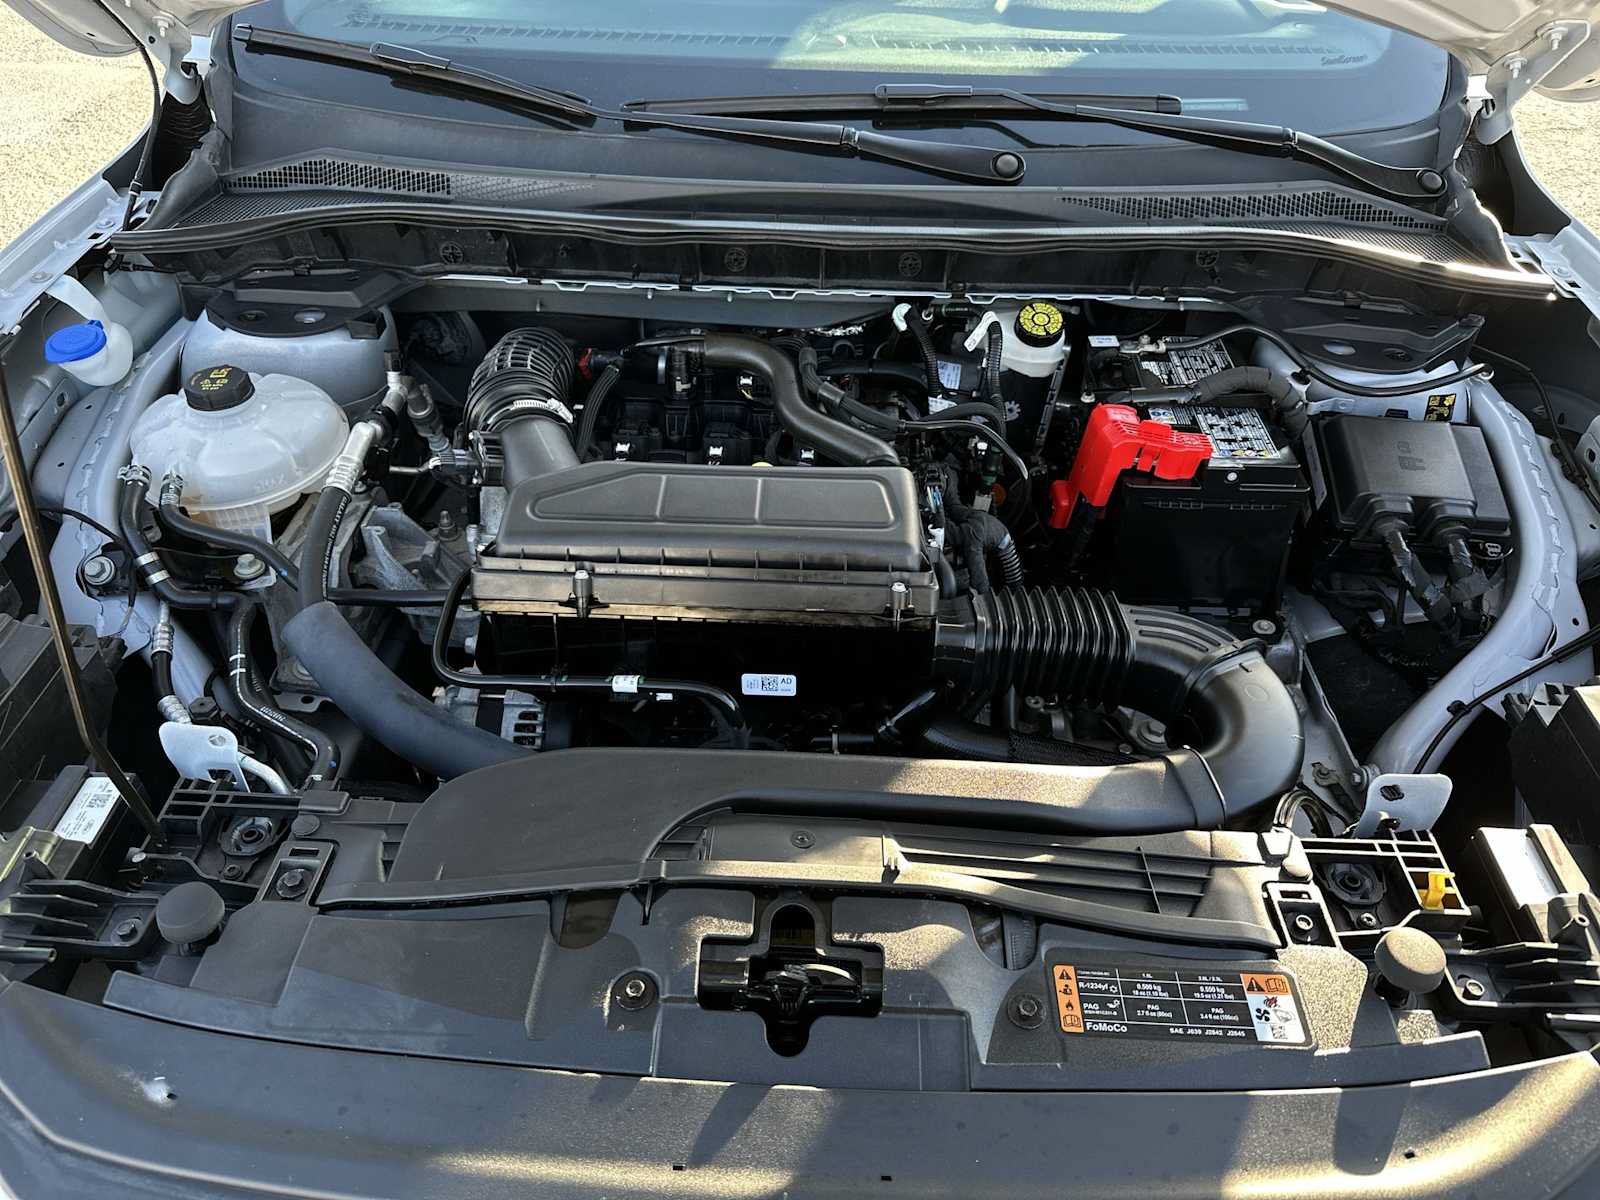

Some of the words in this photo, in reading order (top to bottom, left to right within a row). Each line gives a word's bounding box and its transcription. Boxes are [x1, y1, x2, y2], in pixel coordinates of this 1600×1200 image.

[780, 677, 793, 685] AD
[1078, 982, 1109, 992] R-1234yf
[1152, 984, 1162, 992] kg
[1216, 986, 1225, 994] kg
[1082, 1002, 1100, 1010] PAG
[1086, 1022, 1128, 1034] FoMoCo
